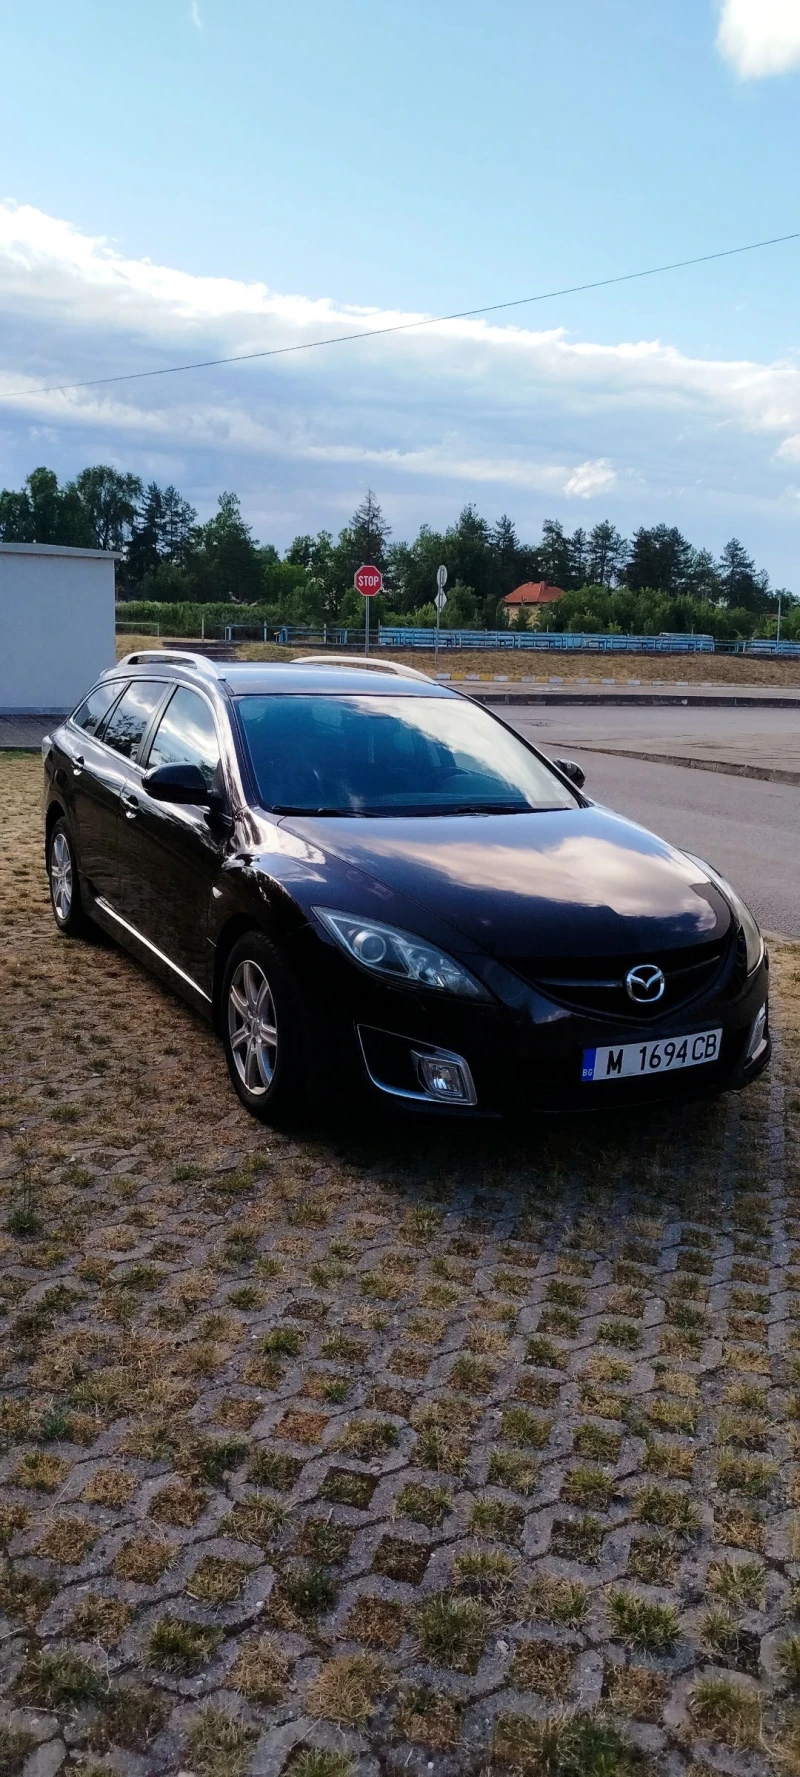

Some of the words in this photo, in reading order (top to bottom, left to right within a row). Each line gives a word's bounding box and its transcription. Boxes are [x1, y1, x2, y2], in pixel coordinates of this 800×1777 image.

[358, 575, 380, 587] STOP
[606, 1049, 624, 1075] M
[582, 1068, 593, 1077] BG
